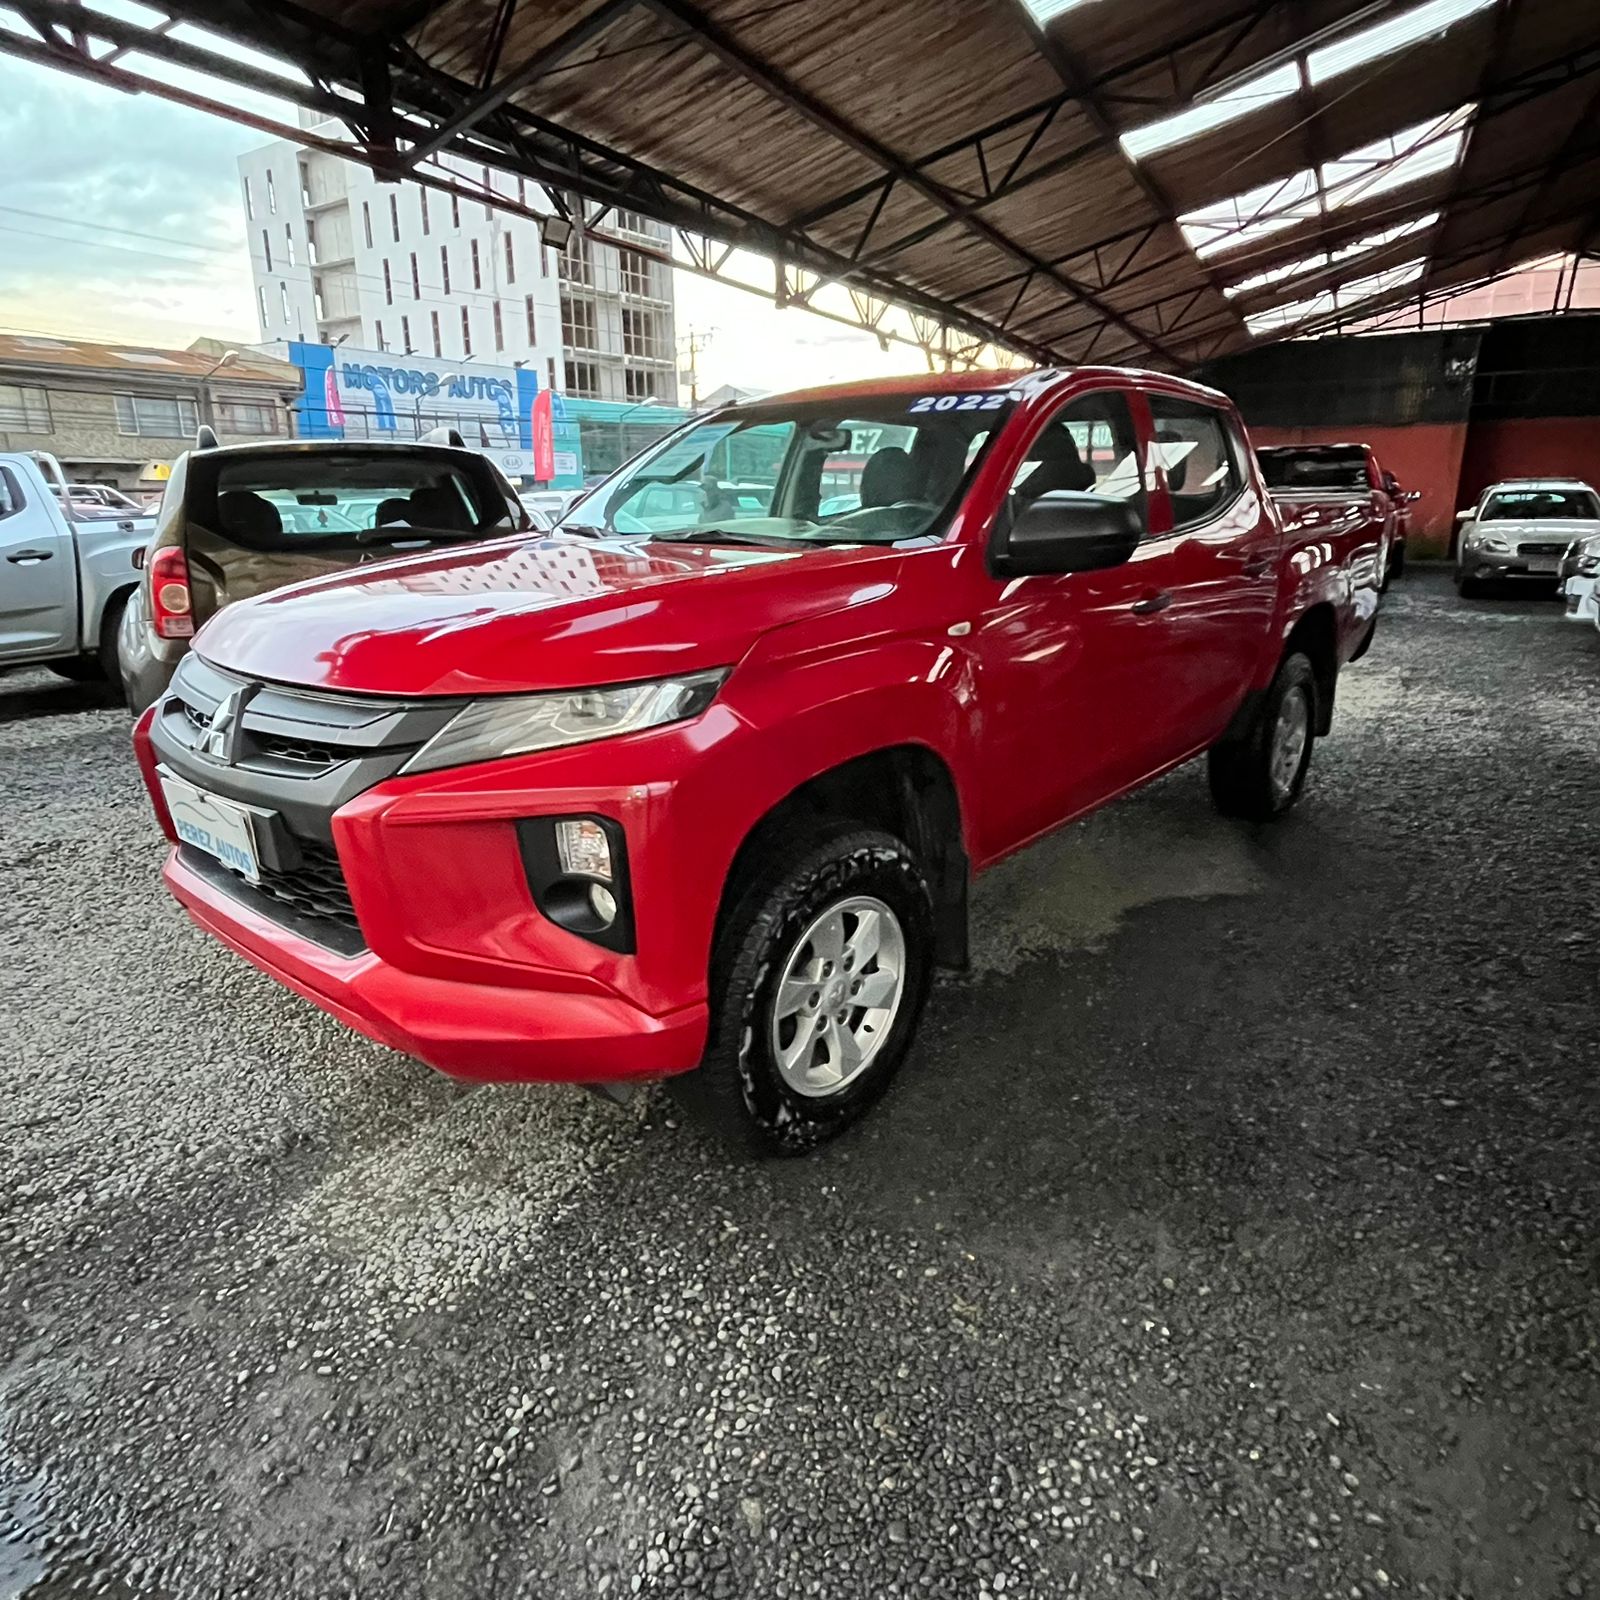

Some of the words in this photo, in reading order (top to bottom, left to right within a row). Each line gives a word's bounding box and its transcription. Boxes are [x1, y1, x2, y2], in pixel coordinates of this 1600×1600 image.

[342, 362, 440, 397] MOTORS
[448, 374, 513, 401] AUTOS
[909, 394, 1006, 413] 2022
[176, 817, 215, 852] PEREZ
[215, 836, 252, 874] AUTOS
